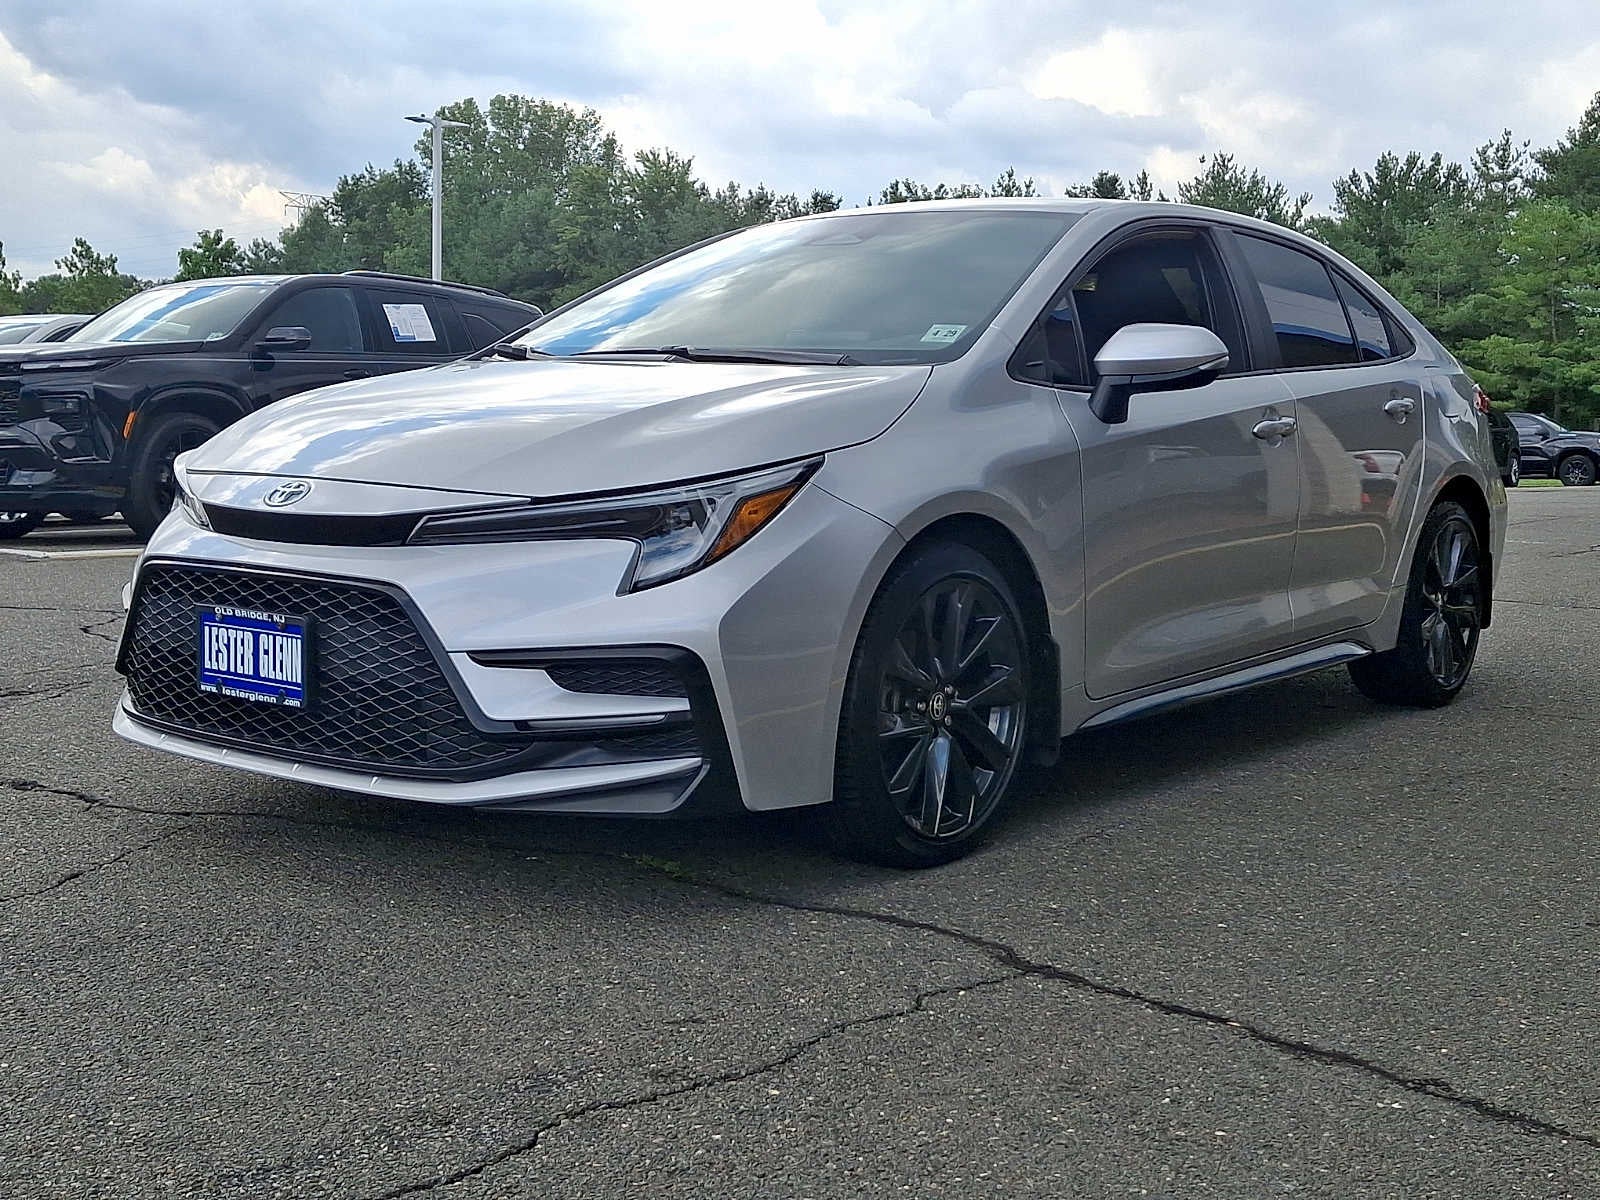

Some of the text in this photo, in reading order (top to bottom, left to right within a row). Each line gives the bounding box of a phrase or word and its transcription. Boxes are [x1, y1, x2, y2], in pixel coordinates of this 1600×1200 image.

[214, 606, 233, 616] OLD
[273, 614, 285, 623] NJ
[204, 625, 302, 684] LESTER GLENN
